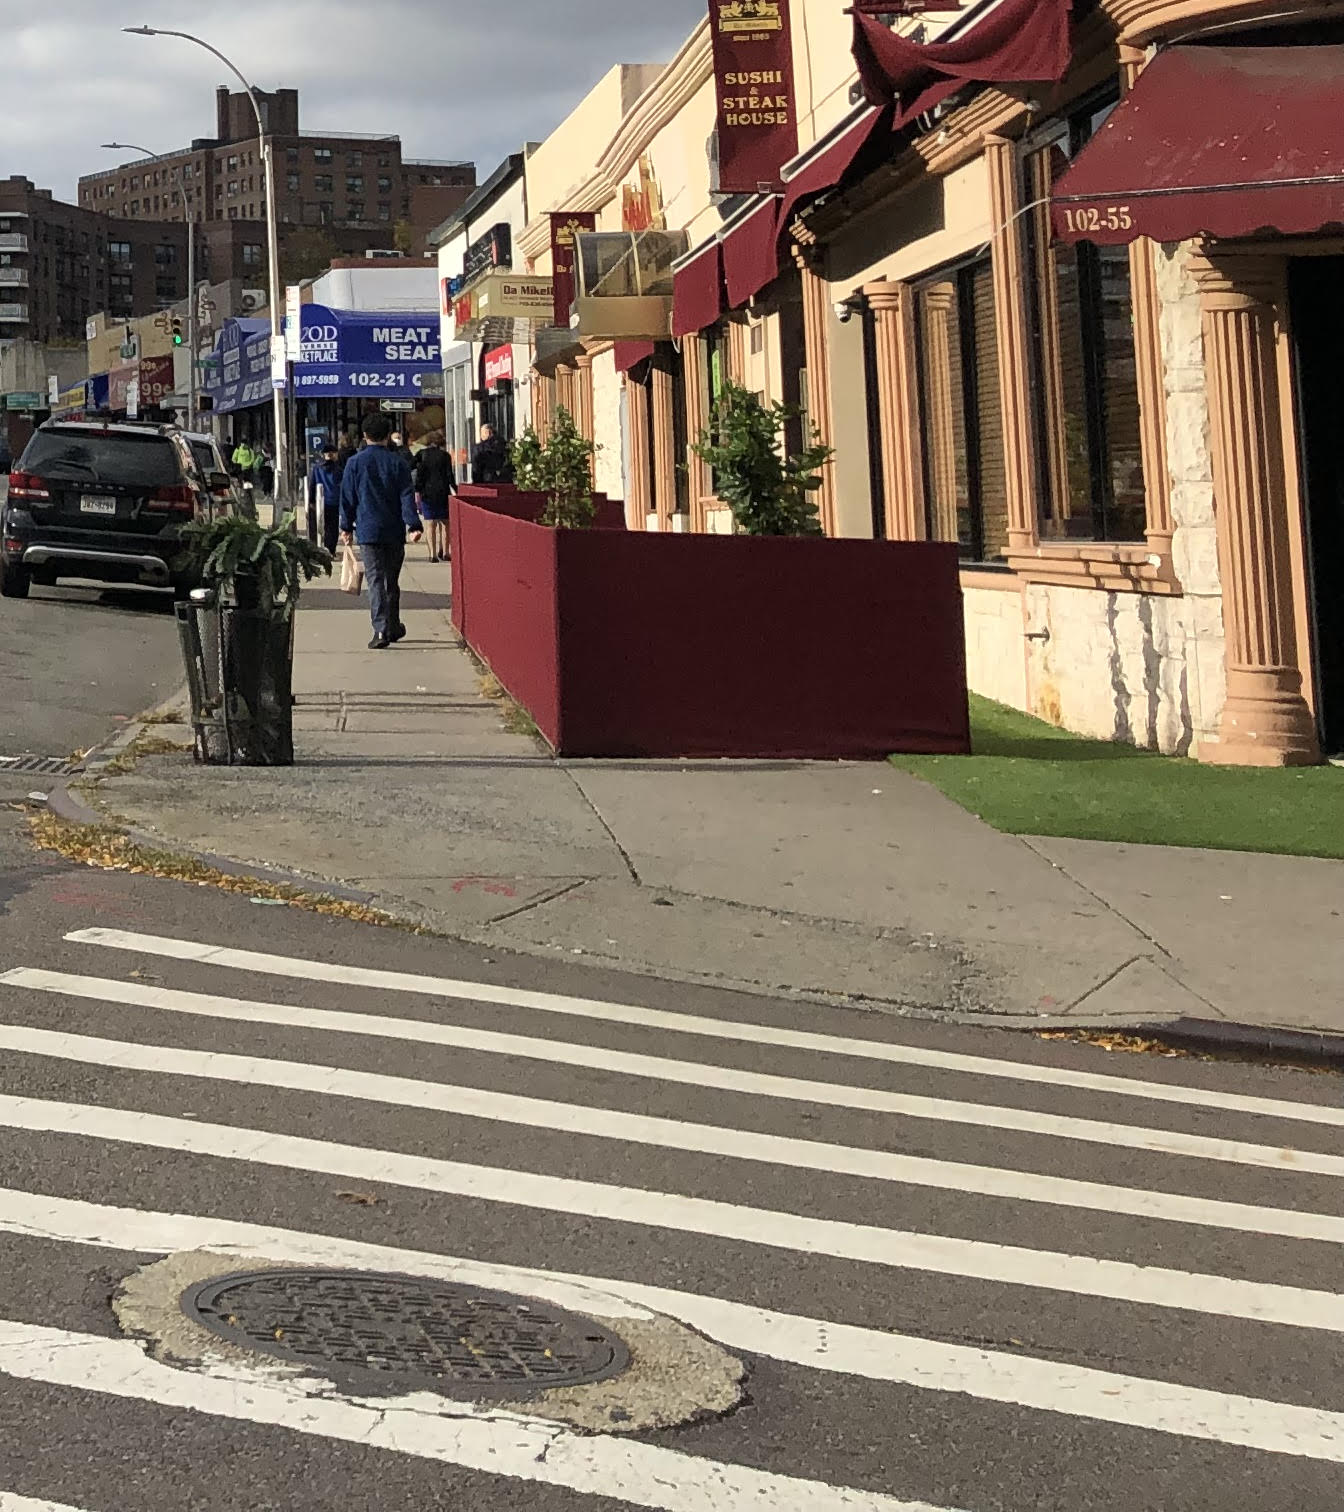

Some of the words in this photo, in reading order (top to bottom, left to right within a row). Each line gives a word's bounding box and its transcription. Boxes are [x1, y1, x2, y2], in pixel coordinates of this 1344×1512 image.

[724, 70, 782, 85] SUSHI
[749, 86, 759, 95] &
[722, 95, 788, 109] STEAK
[725, 111, 788, 126] HOUSE
[1064, 205, 1132, 232] 102-55
[503, 285, 518, 295] Da
[520, 285, 553, 296] Mikell
[372, 327, 431, 343] MEAT
[384, 345, 440, 361] SEAF
[348, 373, 405, 387] 102-21
